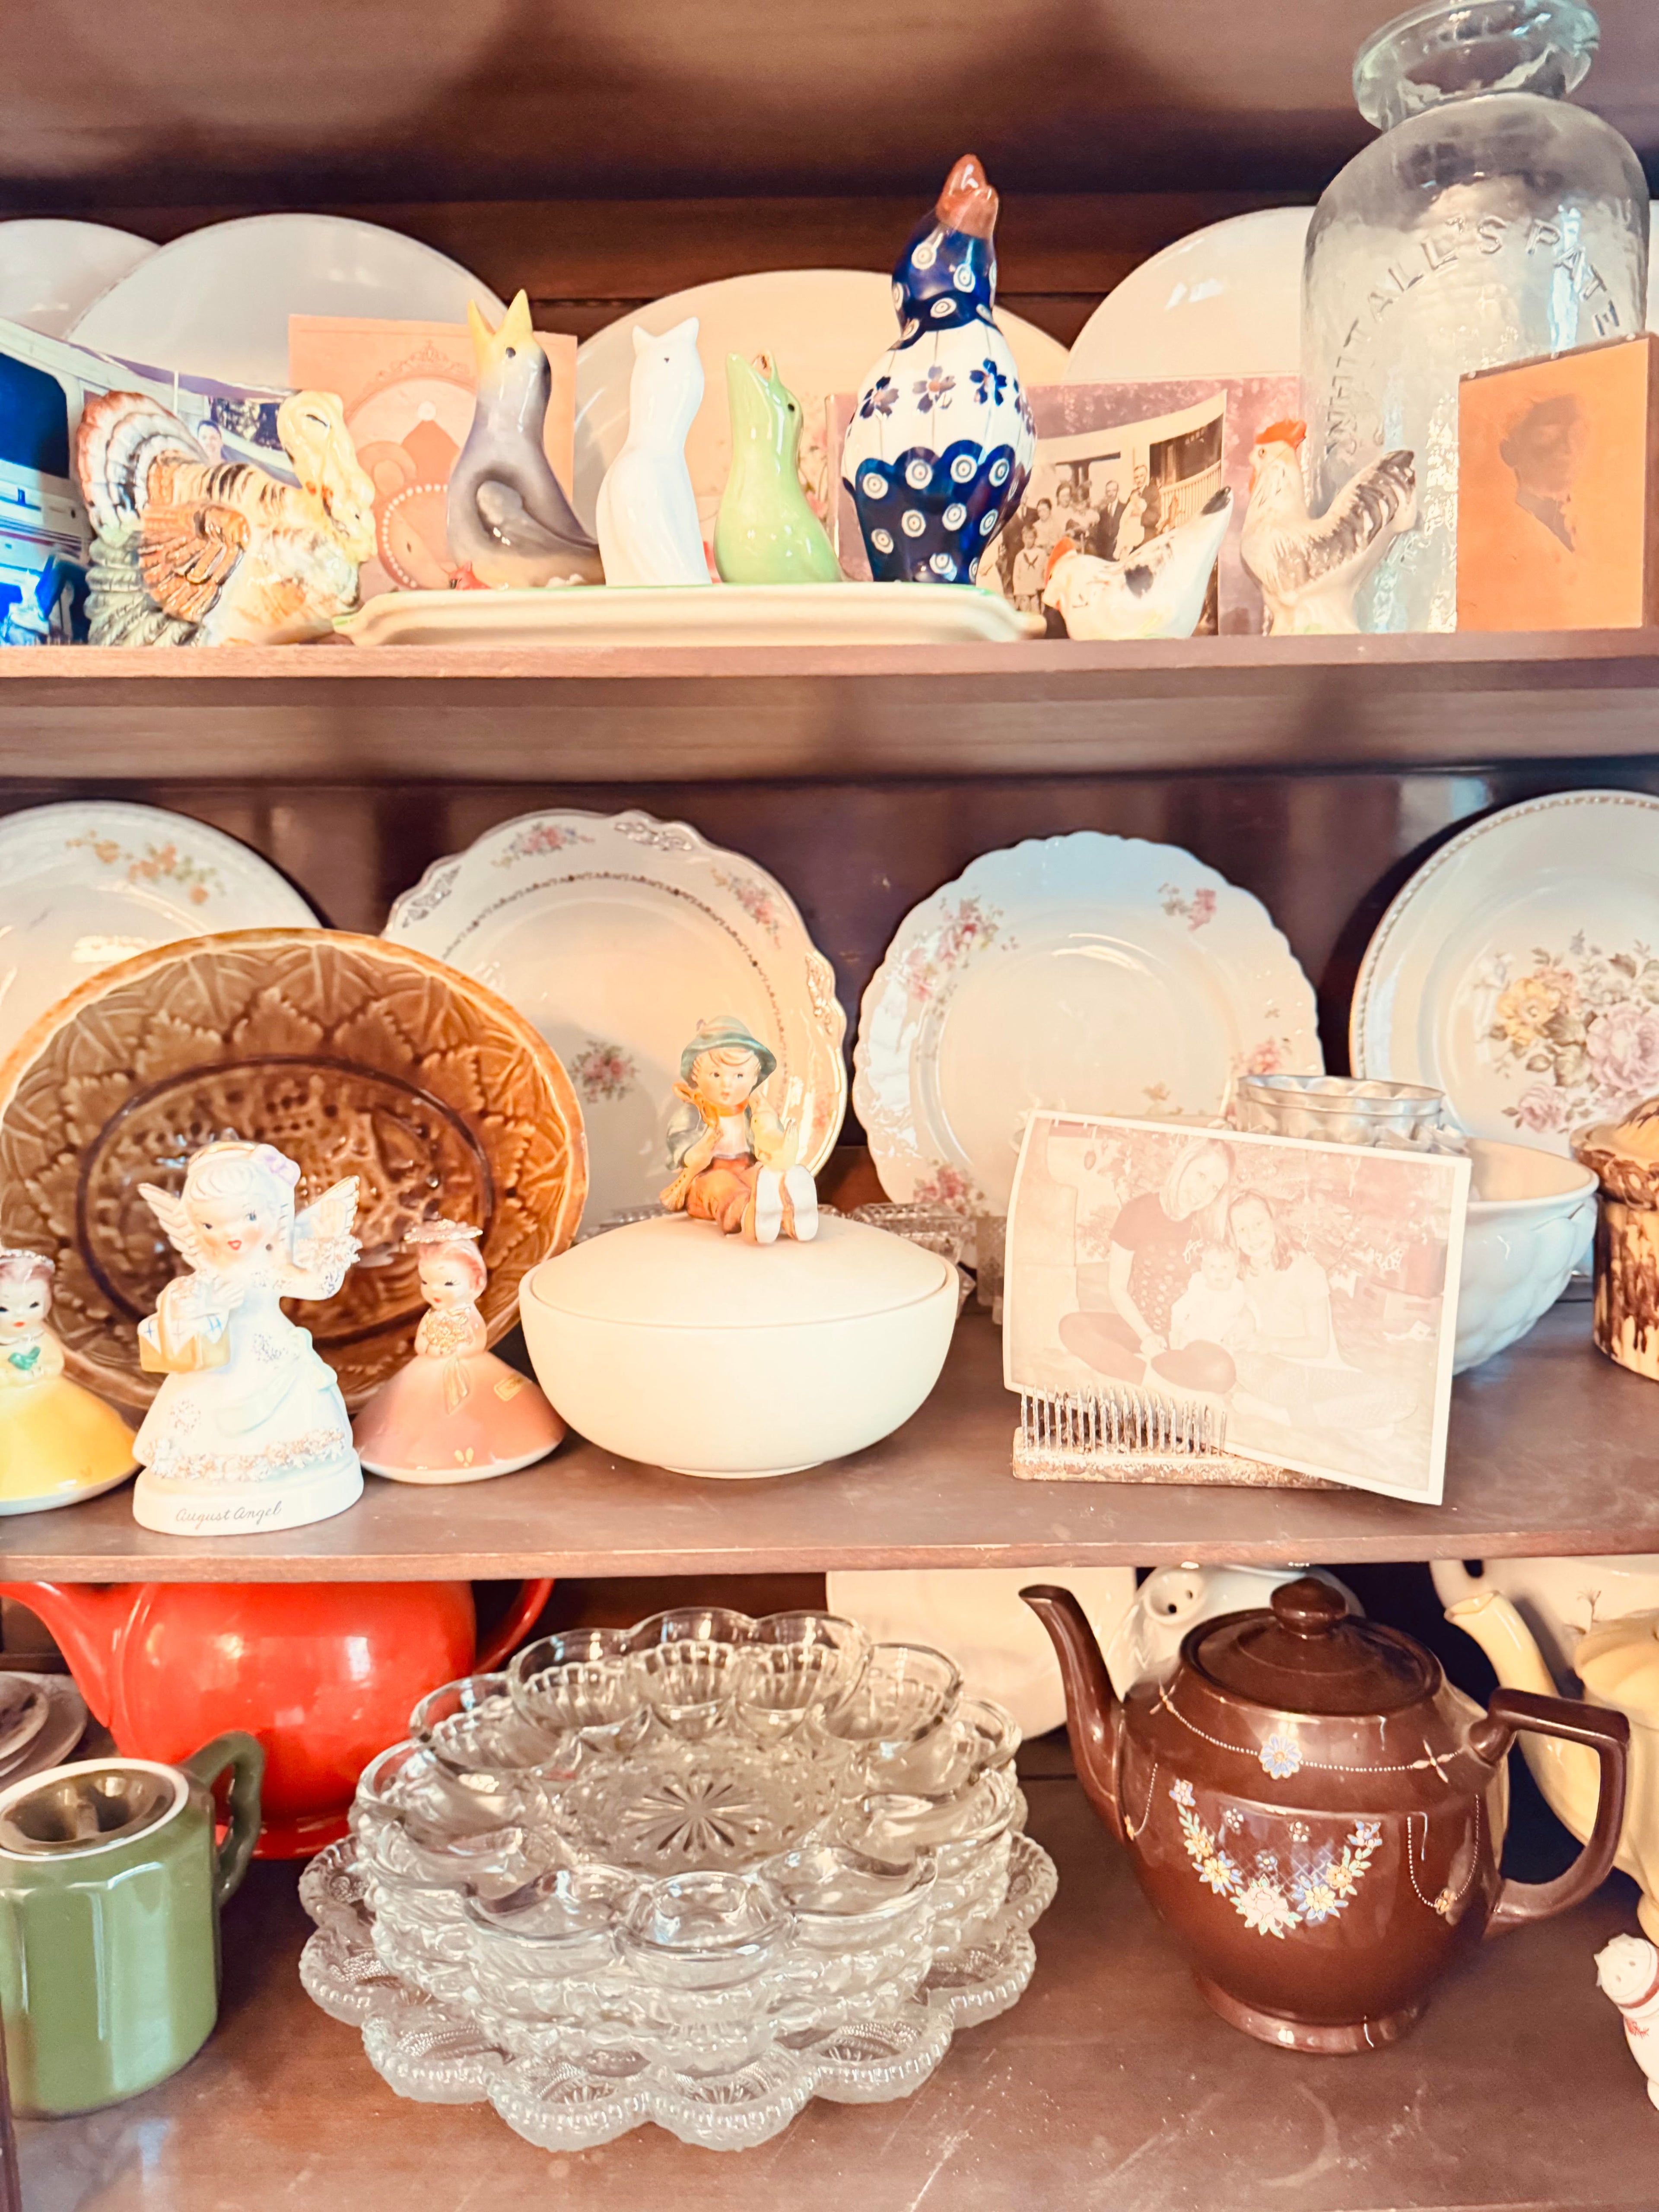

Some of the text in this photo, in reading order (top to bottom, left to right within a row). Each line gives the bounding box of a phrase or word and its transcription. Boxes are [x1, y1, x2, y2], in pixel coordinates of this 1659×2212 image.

[1525, 219, 1620, 337] PATE
[175, 1500, 282, 1530] August Angel
